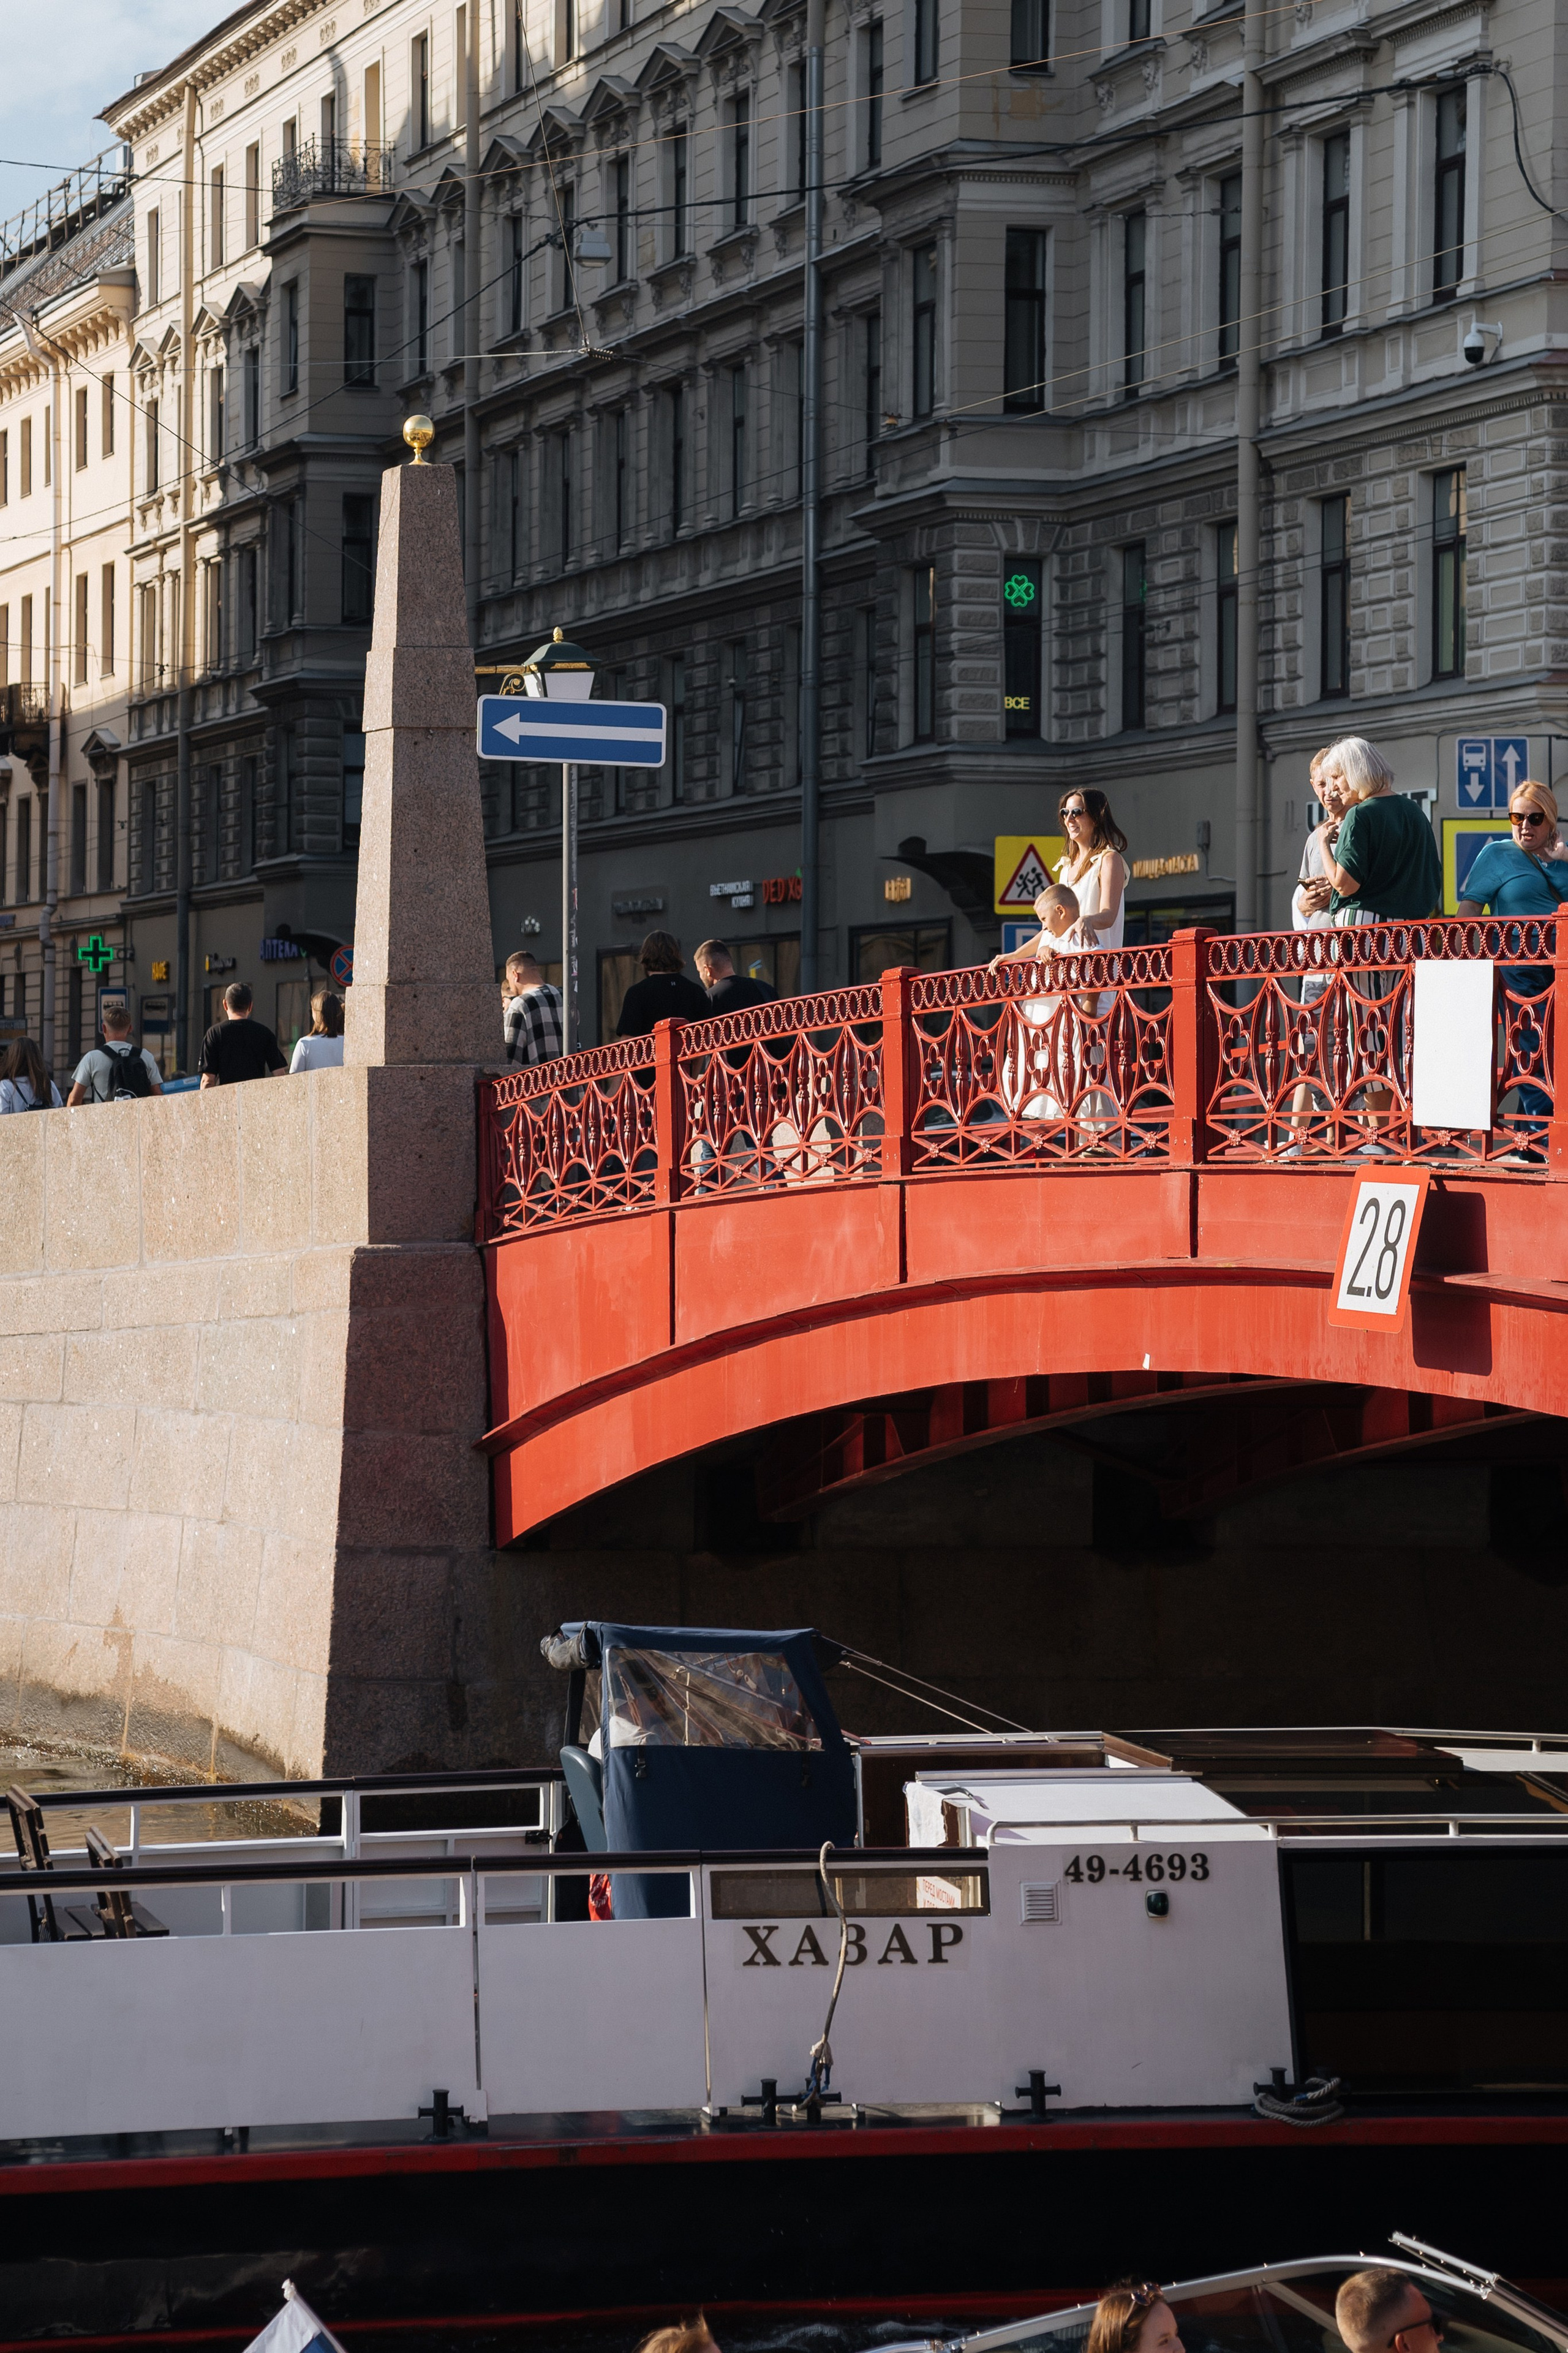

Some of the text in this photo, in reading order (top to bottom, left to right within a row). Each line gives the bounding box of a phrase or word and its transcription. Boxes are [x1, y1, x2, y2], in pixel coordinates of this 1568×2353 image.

[1004, 696, 1030, 709] ВСЕ
[260, 938, 298, 960] АПТЕКА
[1065, 1853, 1210, 1884] 49-4693
[742, 1923, 964, 1966] ХАЗАР
